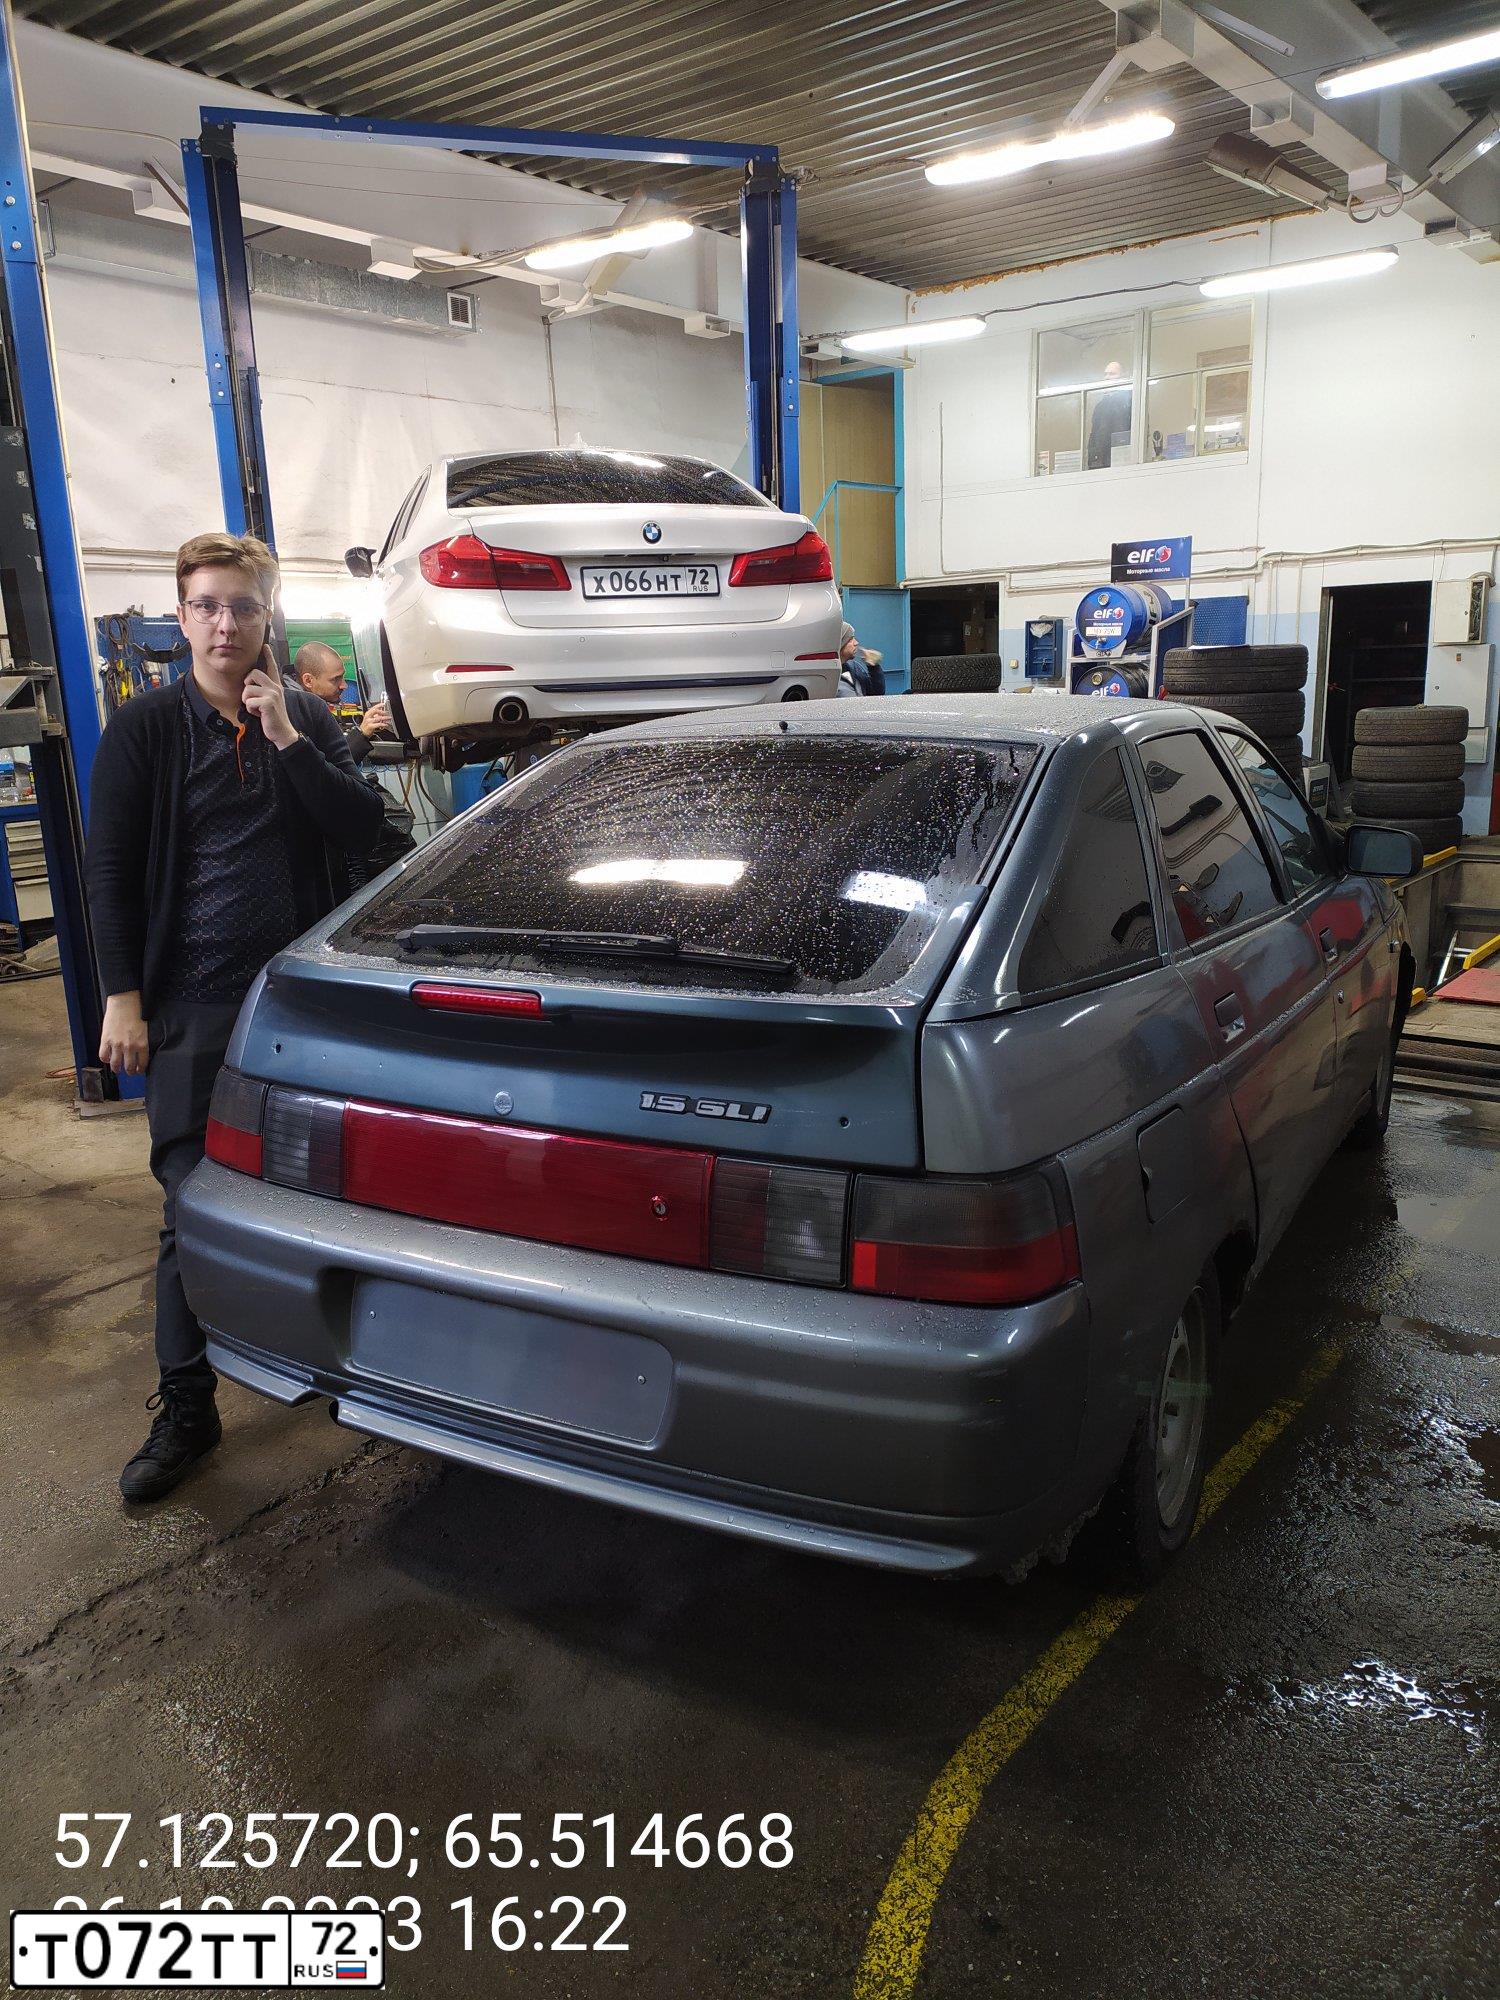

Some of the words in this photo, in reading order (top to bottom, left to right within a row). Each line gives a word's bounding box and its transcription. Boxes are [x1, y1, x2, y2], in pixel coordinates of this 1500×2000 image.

[1127, 548, 1155, 563] elf
[688, 568, 709, 585] 72
[1093, 608, 1113, 619] elf
